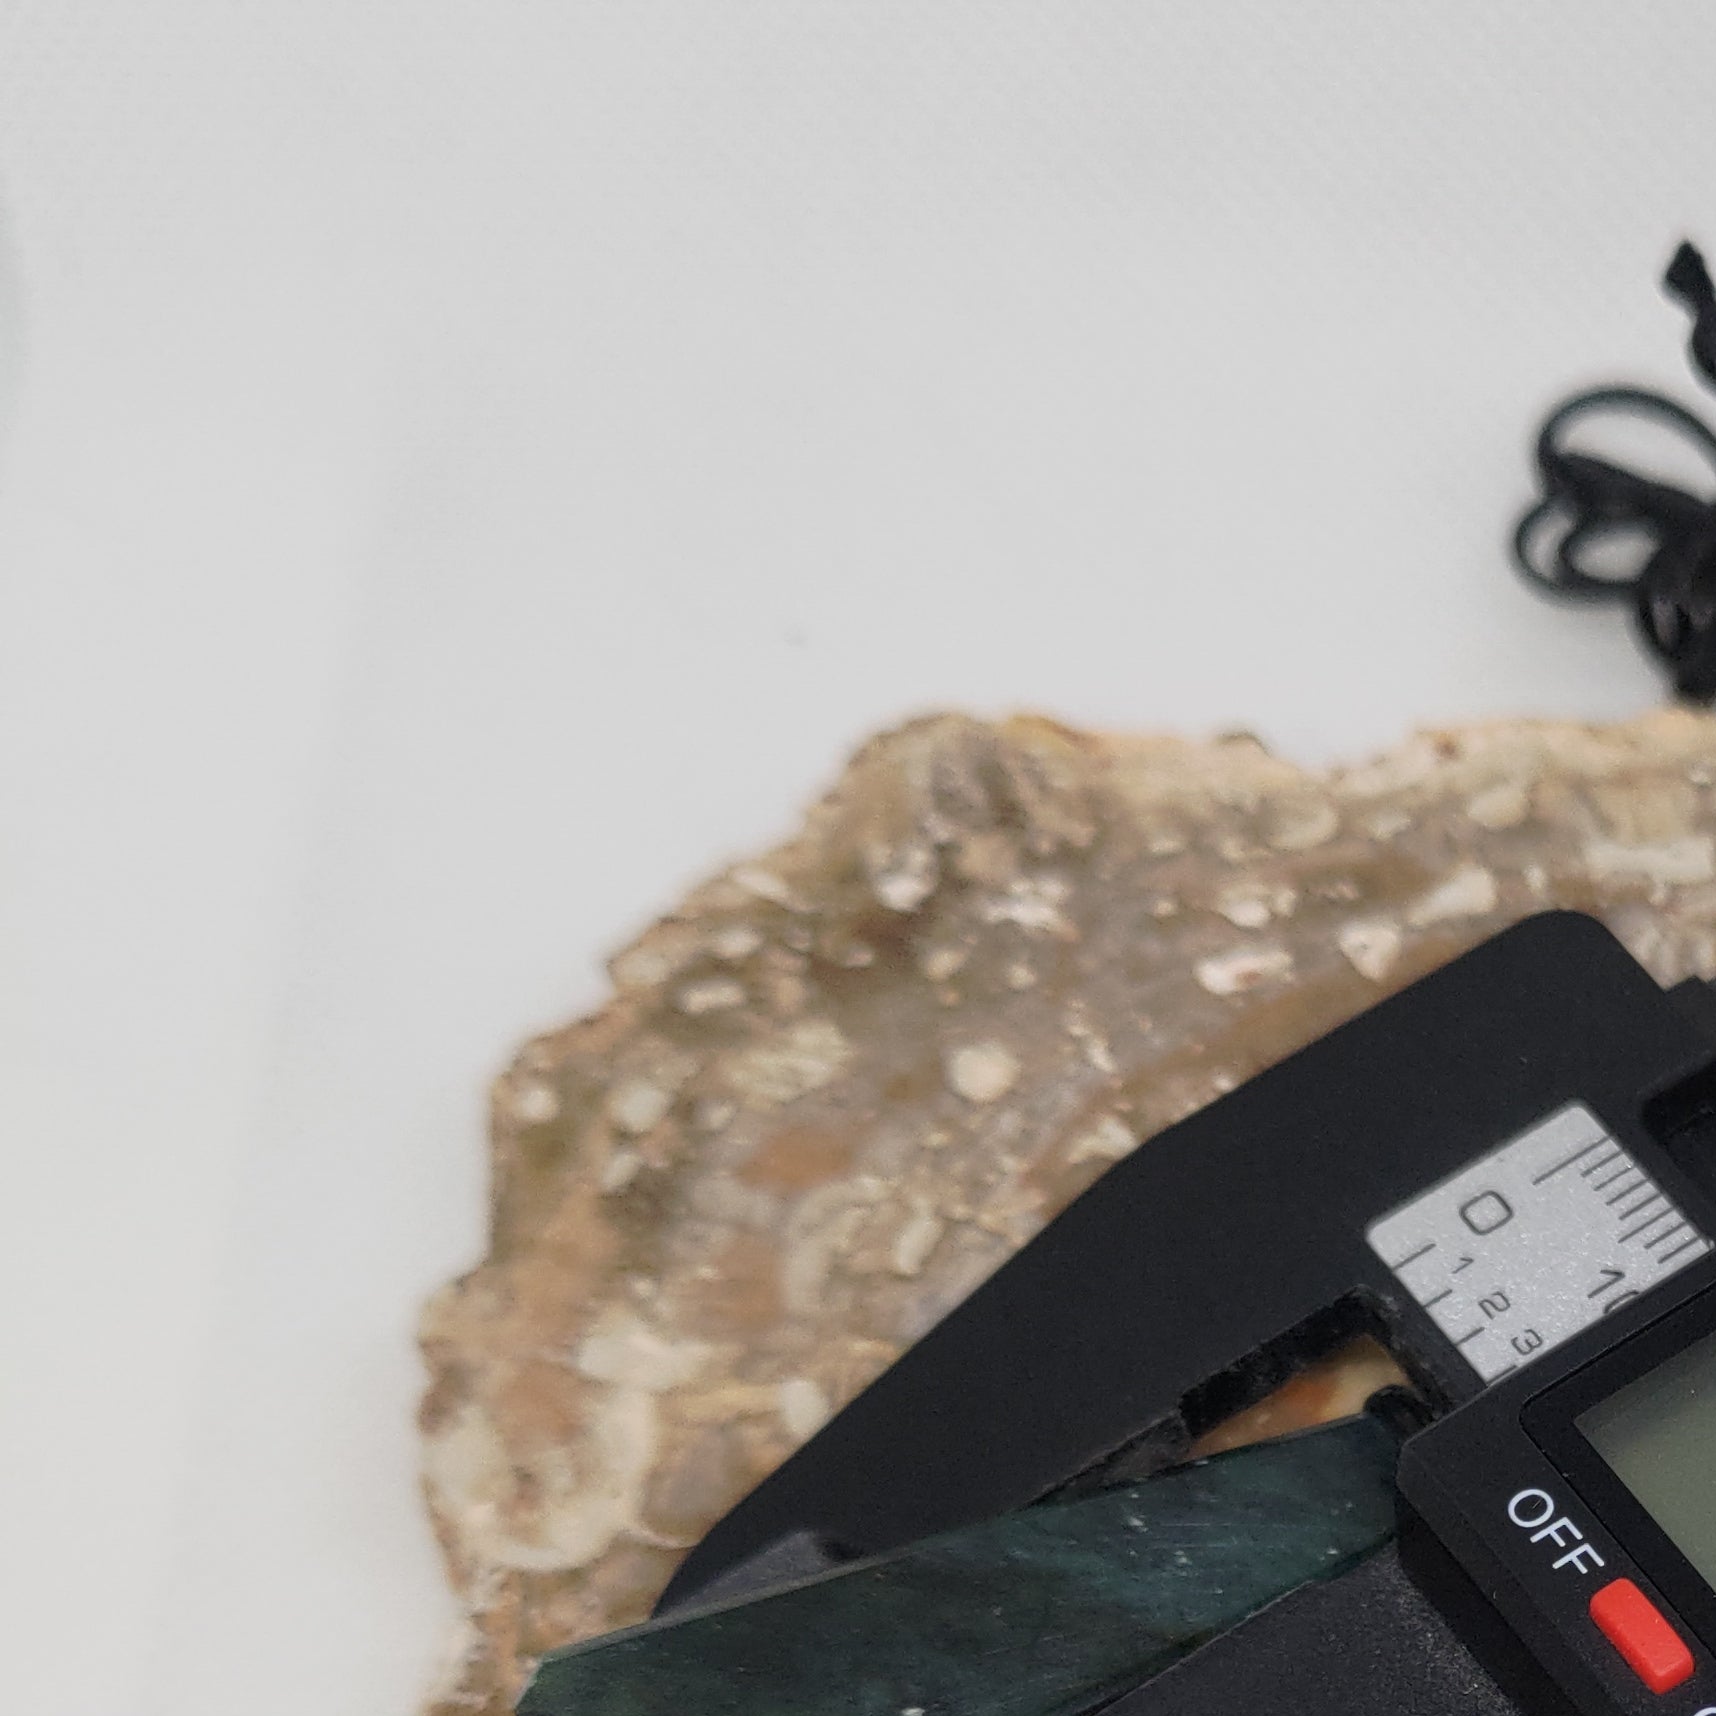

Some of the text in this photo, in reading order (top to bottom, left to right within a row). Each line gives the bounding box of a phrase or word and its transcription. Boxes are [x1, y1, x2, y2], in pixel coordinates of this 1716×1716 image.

[1457, 1188, 1516, 1237] 0
[1451, 1255, 1544, 1356] 1 2 3
[1586, 1267, 1641, 1316] 1
[1506, 1487, 1607, 1576] OFF
